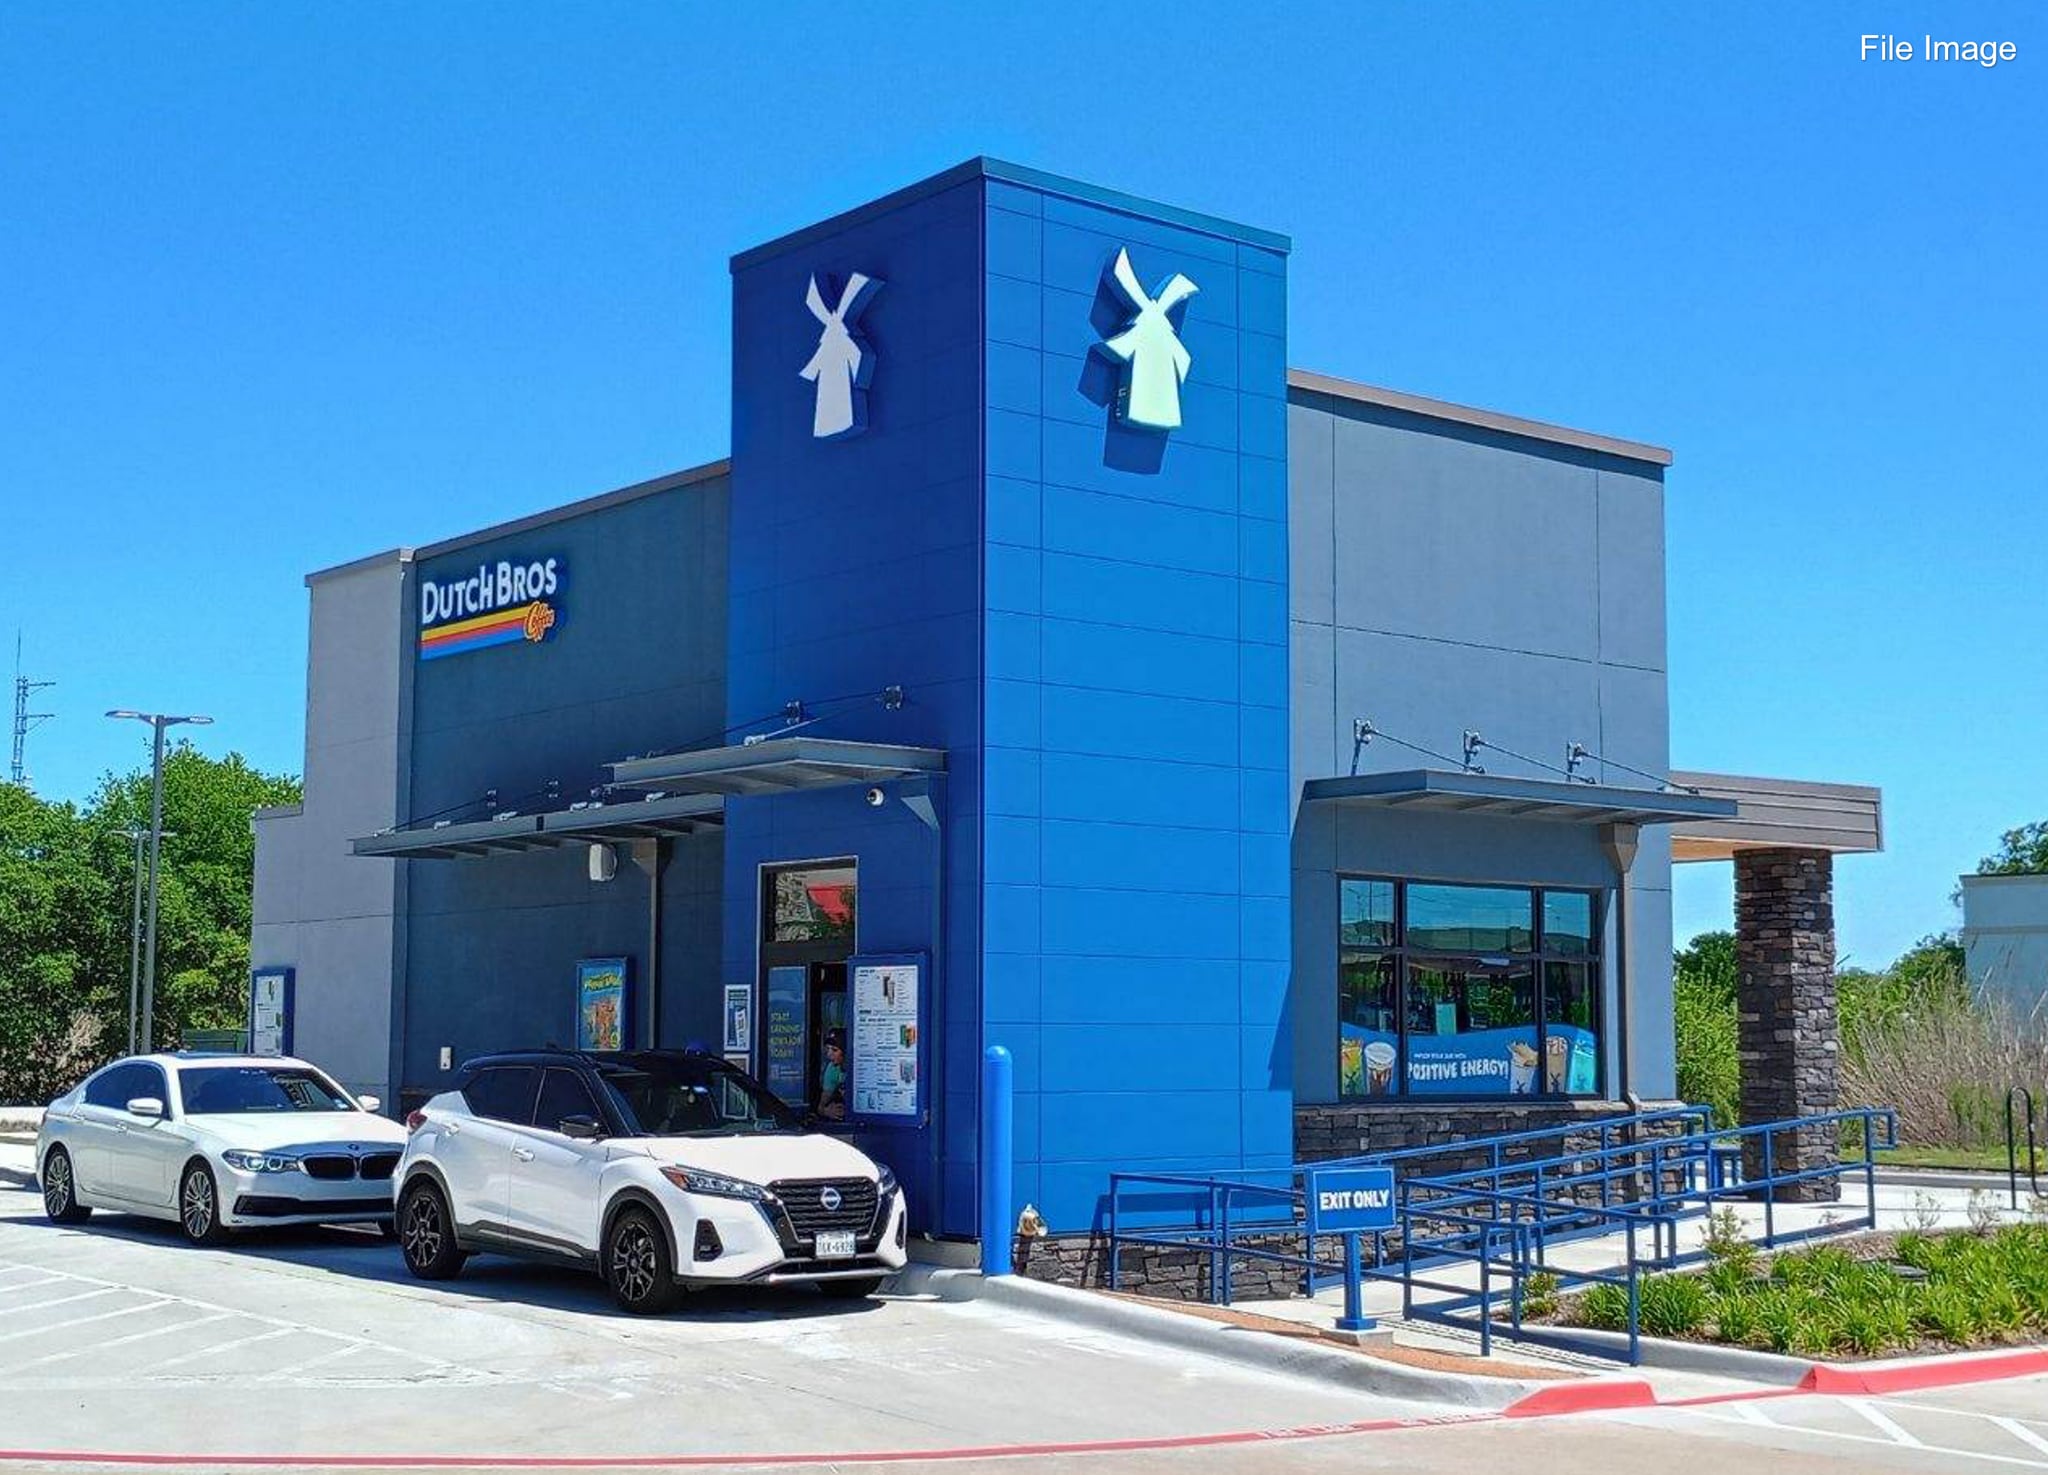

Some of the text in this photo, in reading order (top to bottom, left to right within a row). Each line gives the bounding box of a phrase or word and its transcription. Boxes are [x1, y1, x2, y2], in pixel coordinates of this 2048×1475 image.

[422, 557, 557, 624] DUTCH BROS
[1407, 1058, 1509, 1080] POSITIVE ENERGY!
[1319, 1189, 1390, 1211] EXIT ONLY
